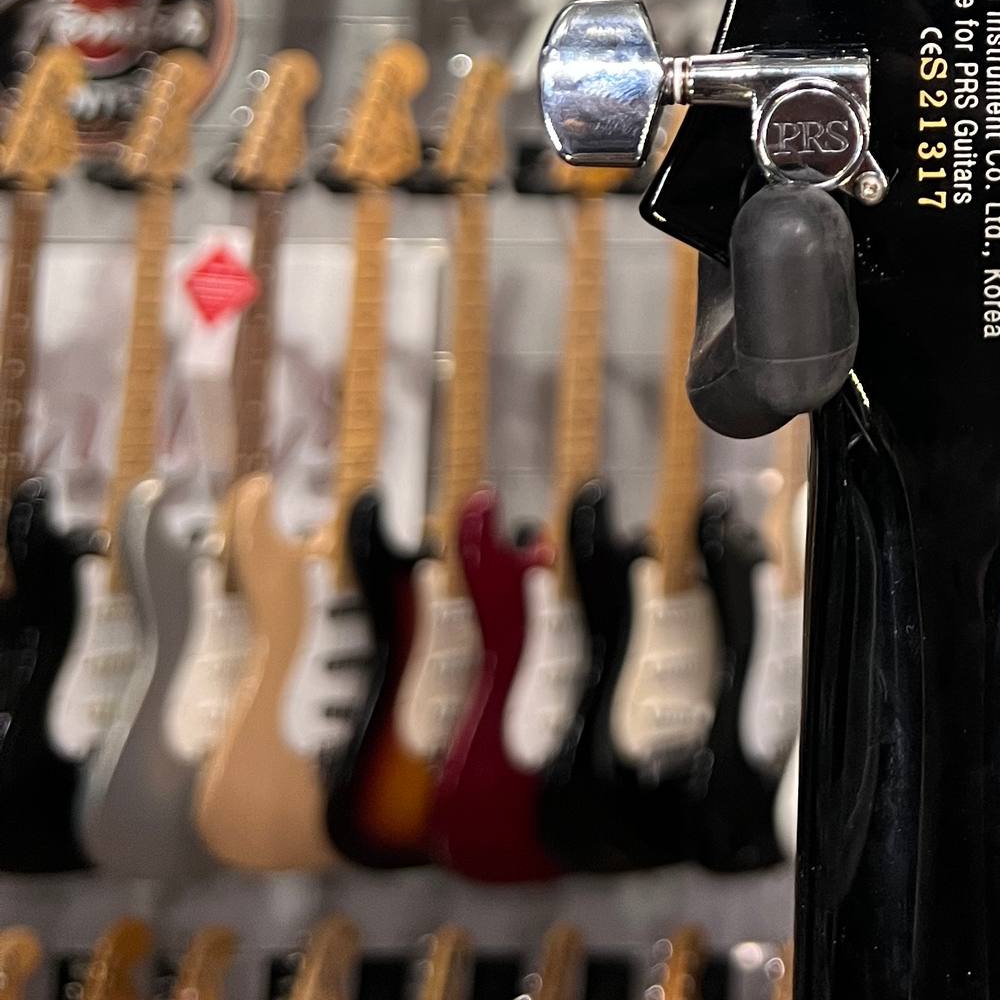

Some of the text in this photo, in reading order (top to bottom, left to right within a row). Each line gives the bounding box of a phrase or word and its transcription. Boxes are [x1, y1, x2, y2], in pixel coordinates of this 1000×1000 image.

[954, 19, 980, 52] for
[954, 62, 979, 109] PRS
[773, 120, 850, 155] PRS
[953, 119, 978, 204] Guitars
